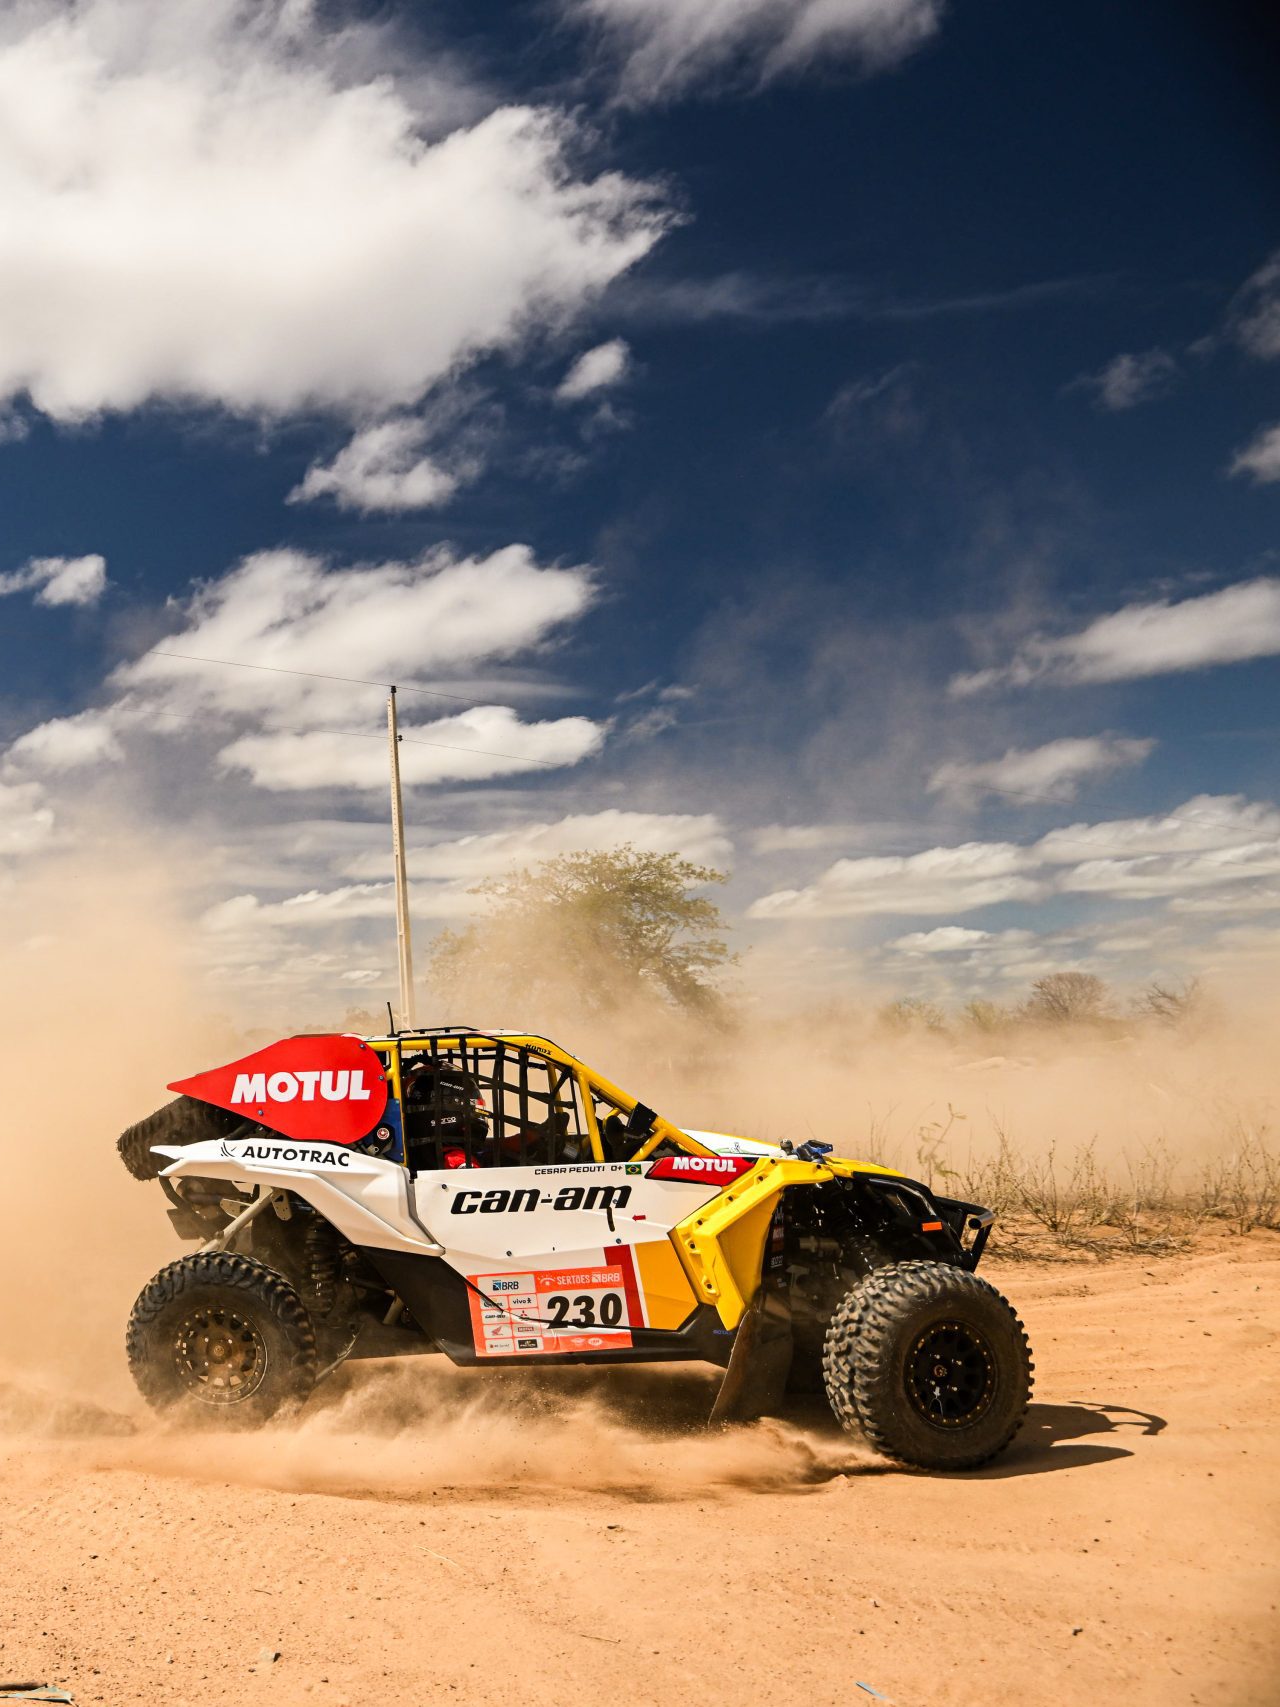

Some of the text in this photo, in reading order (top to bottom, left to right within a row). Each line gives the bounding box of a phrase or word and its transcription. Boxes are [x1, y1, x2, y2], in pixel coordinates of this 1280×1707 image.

[230, 1070, 371, 1104] MOTUL
[242, 1146, 350, 1167] AUTOTRAC
[672, 1156, 737, 1173] MOTUL
[568, 1165, 605, 1173] PEDUTI
[450, 1185, 632, 1215] can-am
[501, 1281, 519, 1291] BRB
[601, 1272, 620, 1283] BRB
[547, 1293, 623, 1329] 230
